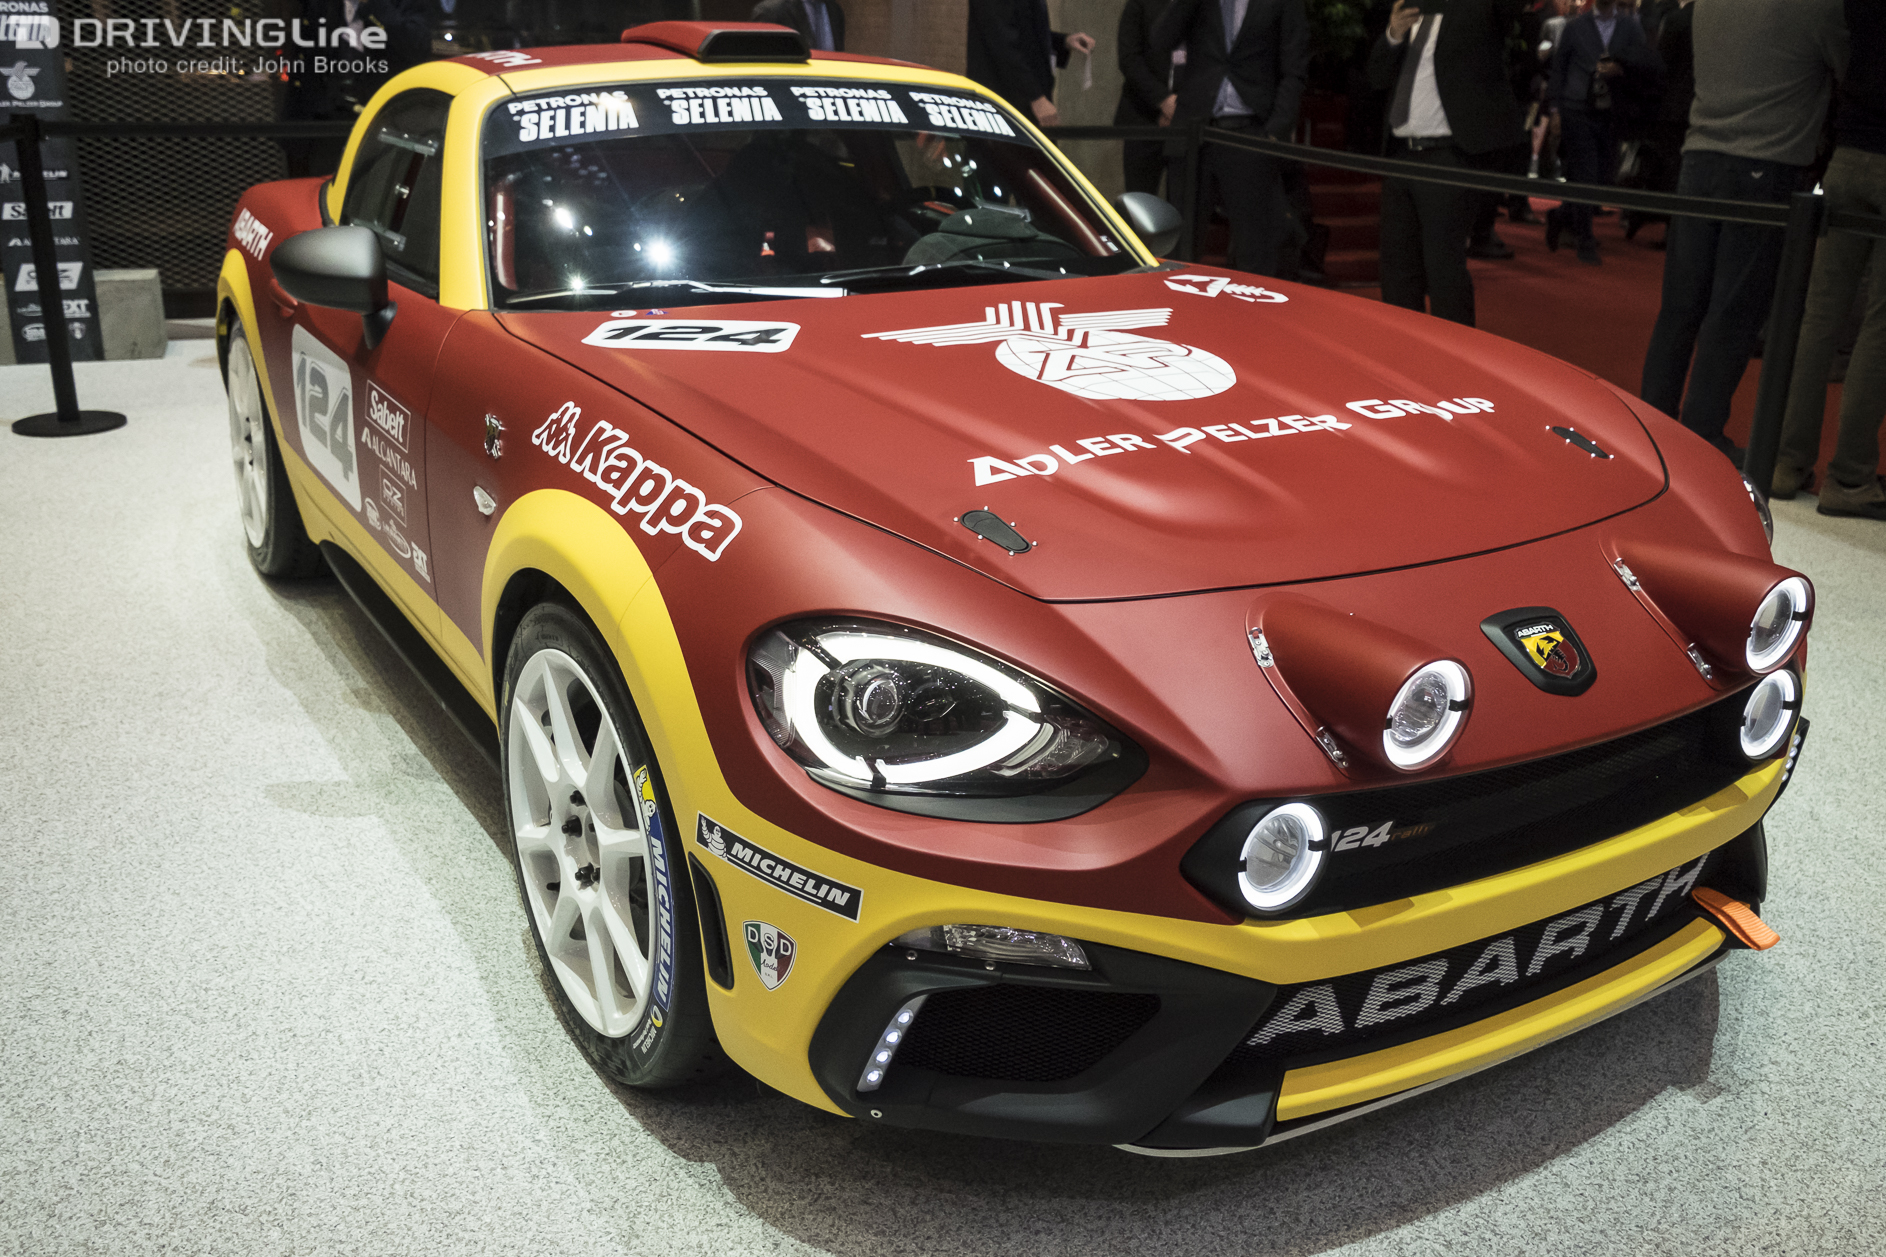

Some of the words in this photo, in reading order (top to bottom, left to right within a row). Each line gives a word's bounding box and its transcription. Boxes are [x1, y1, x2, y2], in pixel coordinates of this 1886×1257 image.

[507, 91, 629, 114] PETRONAS
[656, 86, 769, 99] PETRONAS
[790, 86, 892, 100] PETRONAS
[909, 91, 997, 113] PETRONAS
[519, 101, 640, 142] SELENIA
[671, 96, 783, 125] SELENIA
[805, 97, 909, 124] SELENIA
[925, 103, 1017, 137] SELENIA
[602, 325, 789, 346] 124
[296, 351, 354, 482] 124
[370, 390, 405, 443] Sabelt
[967, 433, 1157, 487] ADLER
[1152, 414, 1352, 455] PELZER
[570, 420, 743, 562] Kappa
[1517, 624, 1554, 638] ABARTH
[1330, 821, 1393, 852] 124
[730, 841, 851, 906] MICHELIN
[650, 836, 671, 1003] MICHELIN
[1246, 851, 1711, 1047] ABARTH
